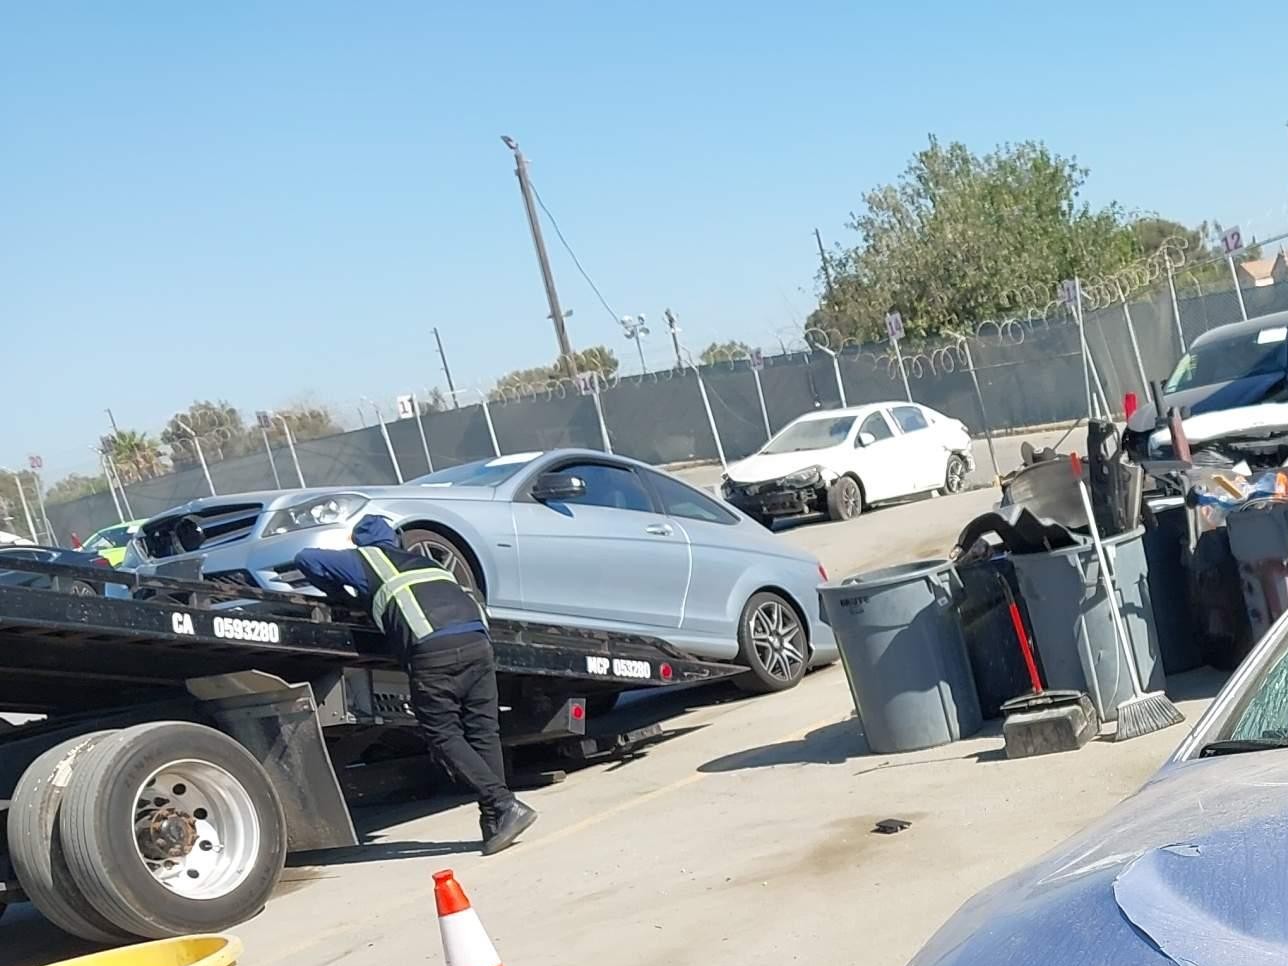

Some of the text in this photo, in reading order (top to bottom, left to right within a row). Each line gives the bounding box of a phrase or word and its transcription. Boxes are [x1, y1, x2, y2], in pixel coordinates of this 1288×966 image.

[1221, 231, 1243, 254] 12
[29, 455, 43, 469] 20
[172, 612, 279, 642] CA 0593280
